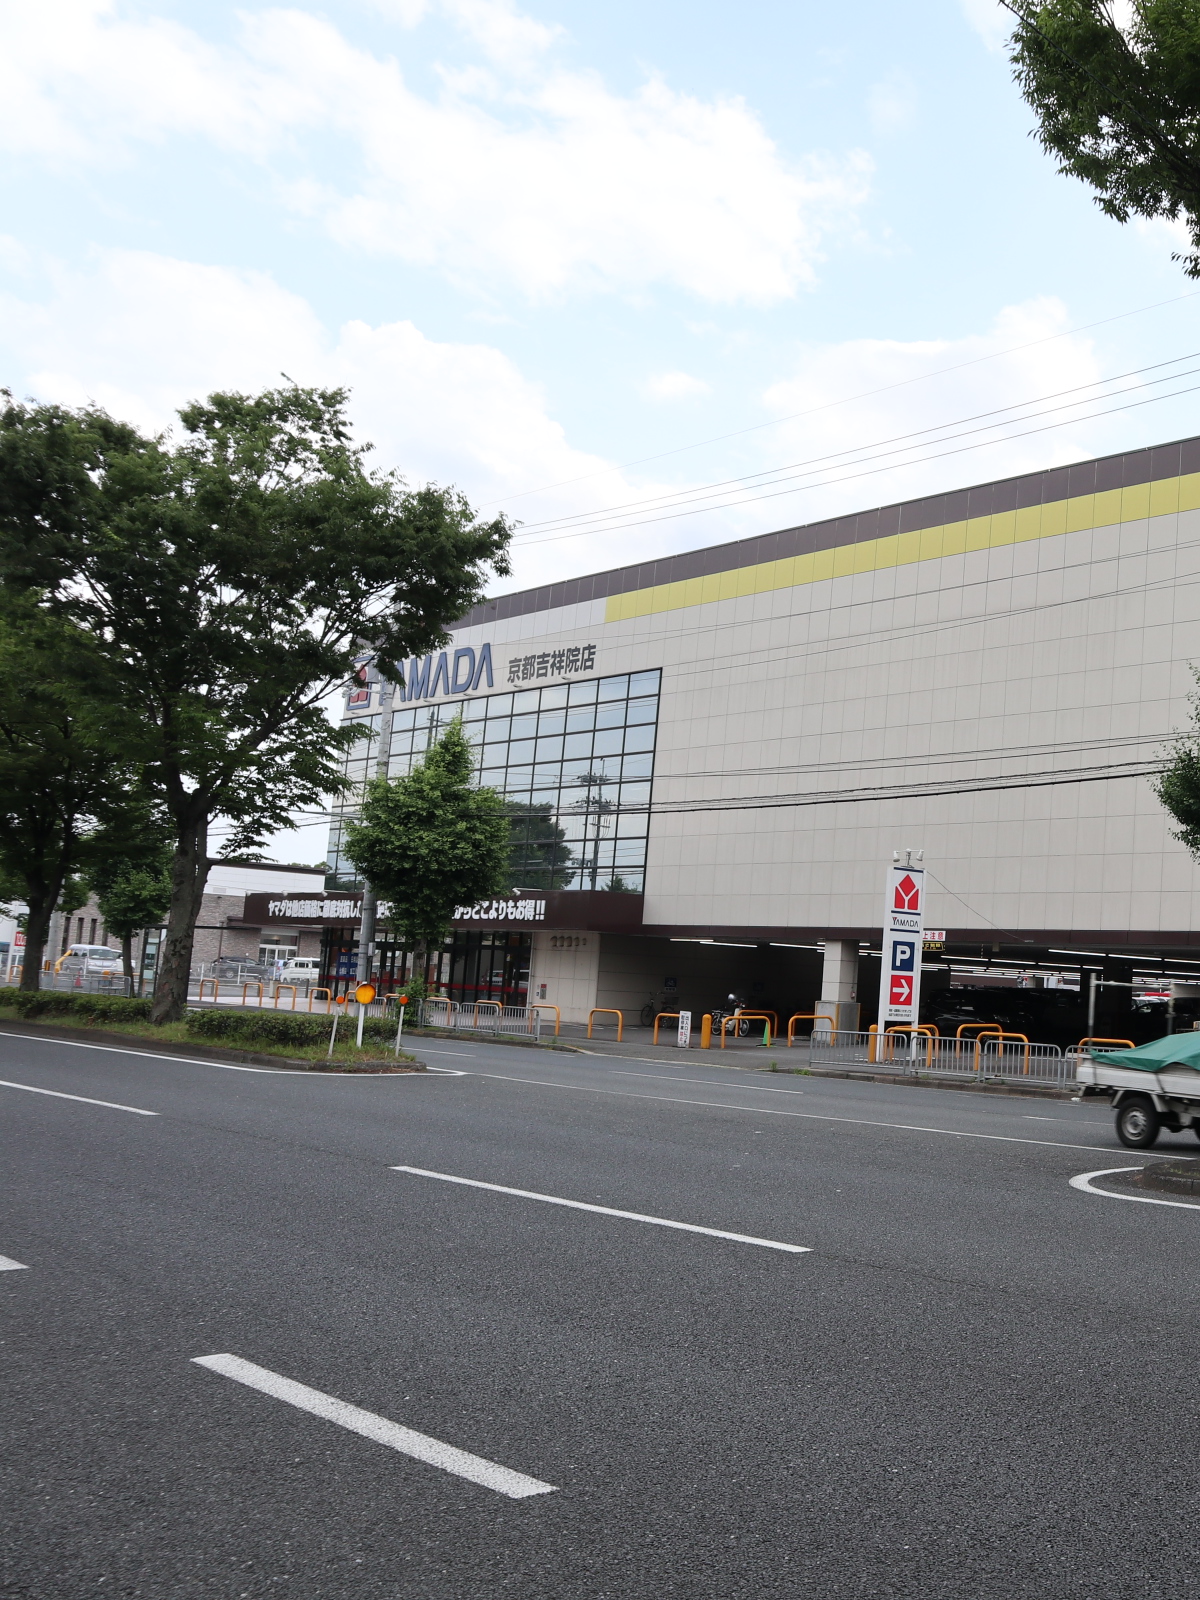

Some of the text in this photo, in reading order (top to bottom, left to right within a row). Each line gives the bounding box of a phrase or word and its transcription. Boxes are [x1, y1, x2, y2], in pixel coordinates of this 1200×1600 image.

[507, 644, 597, 684] 京都吉祥院店
[892, 917, 919, 928] YAMADA
[895, 945, 911, 967] P
